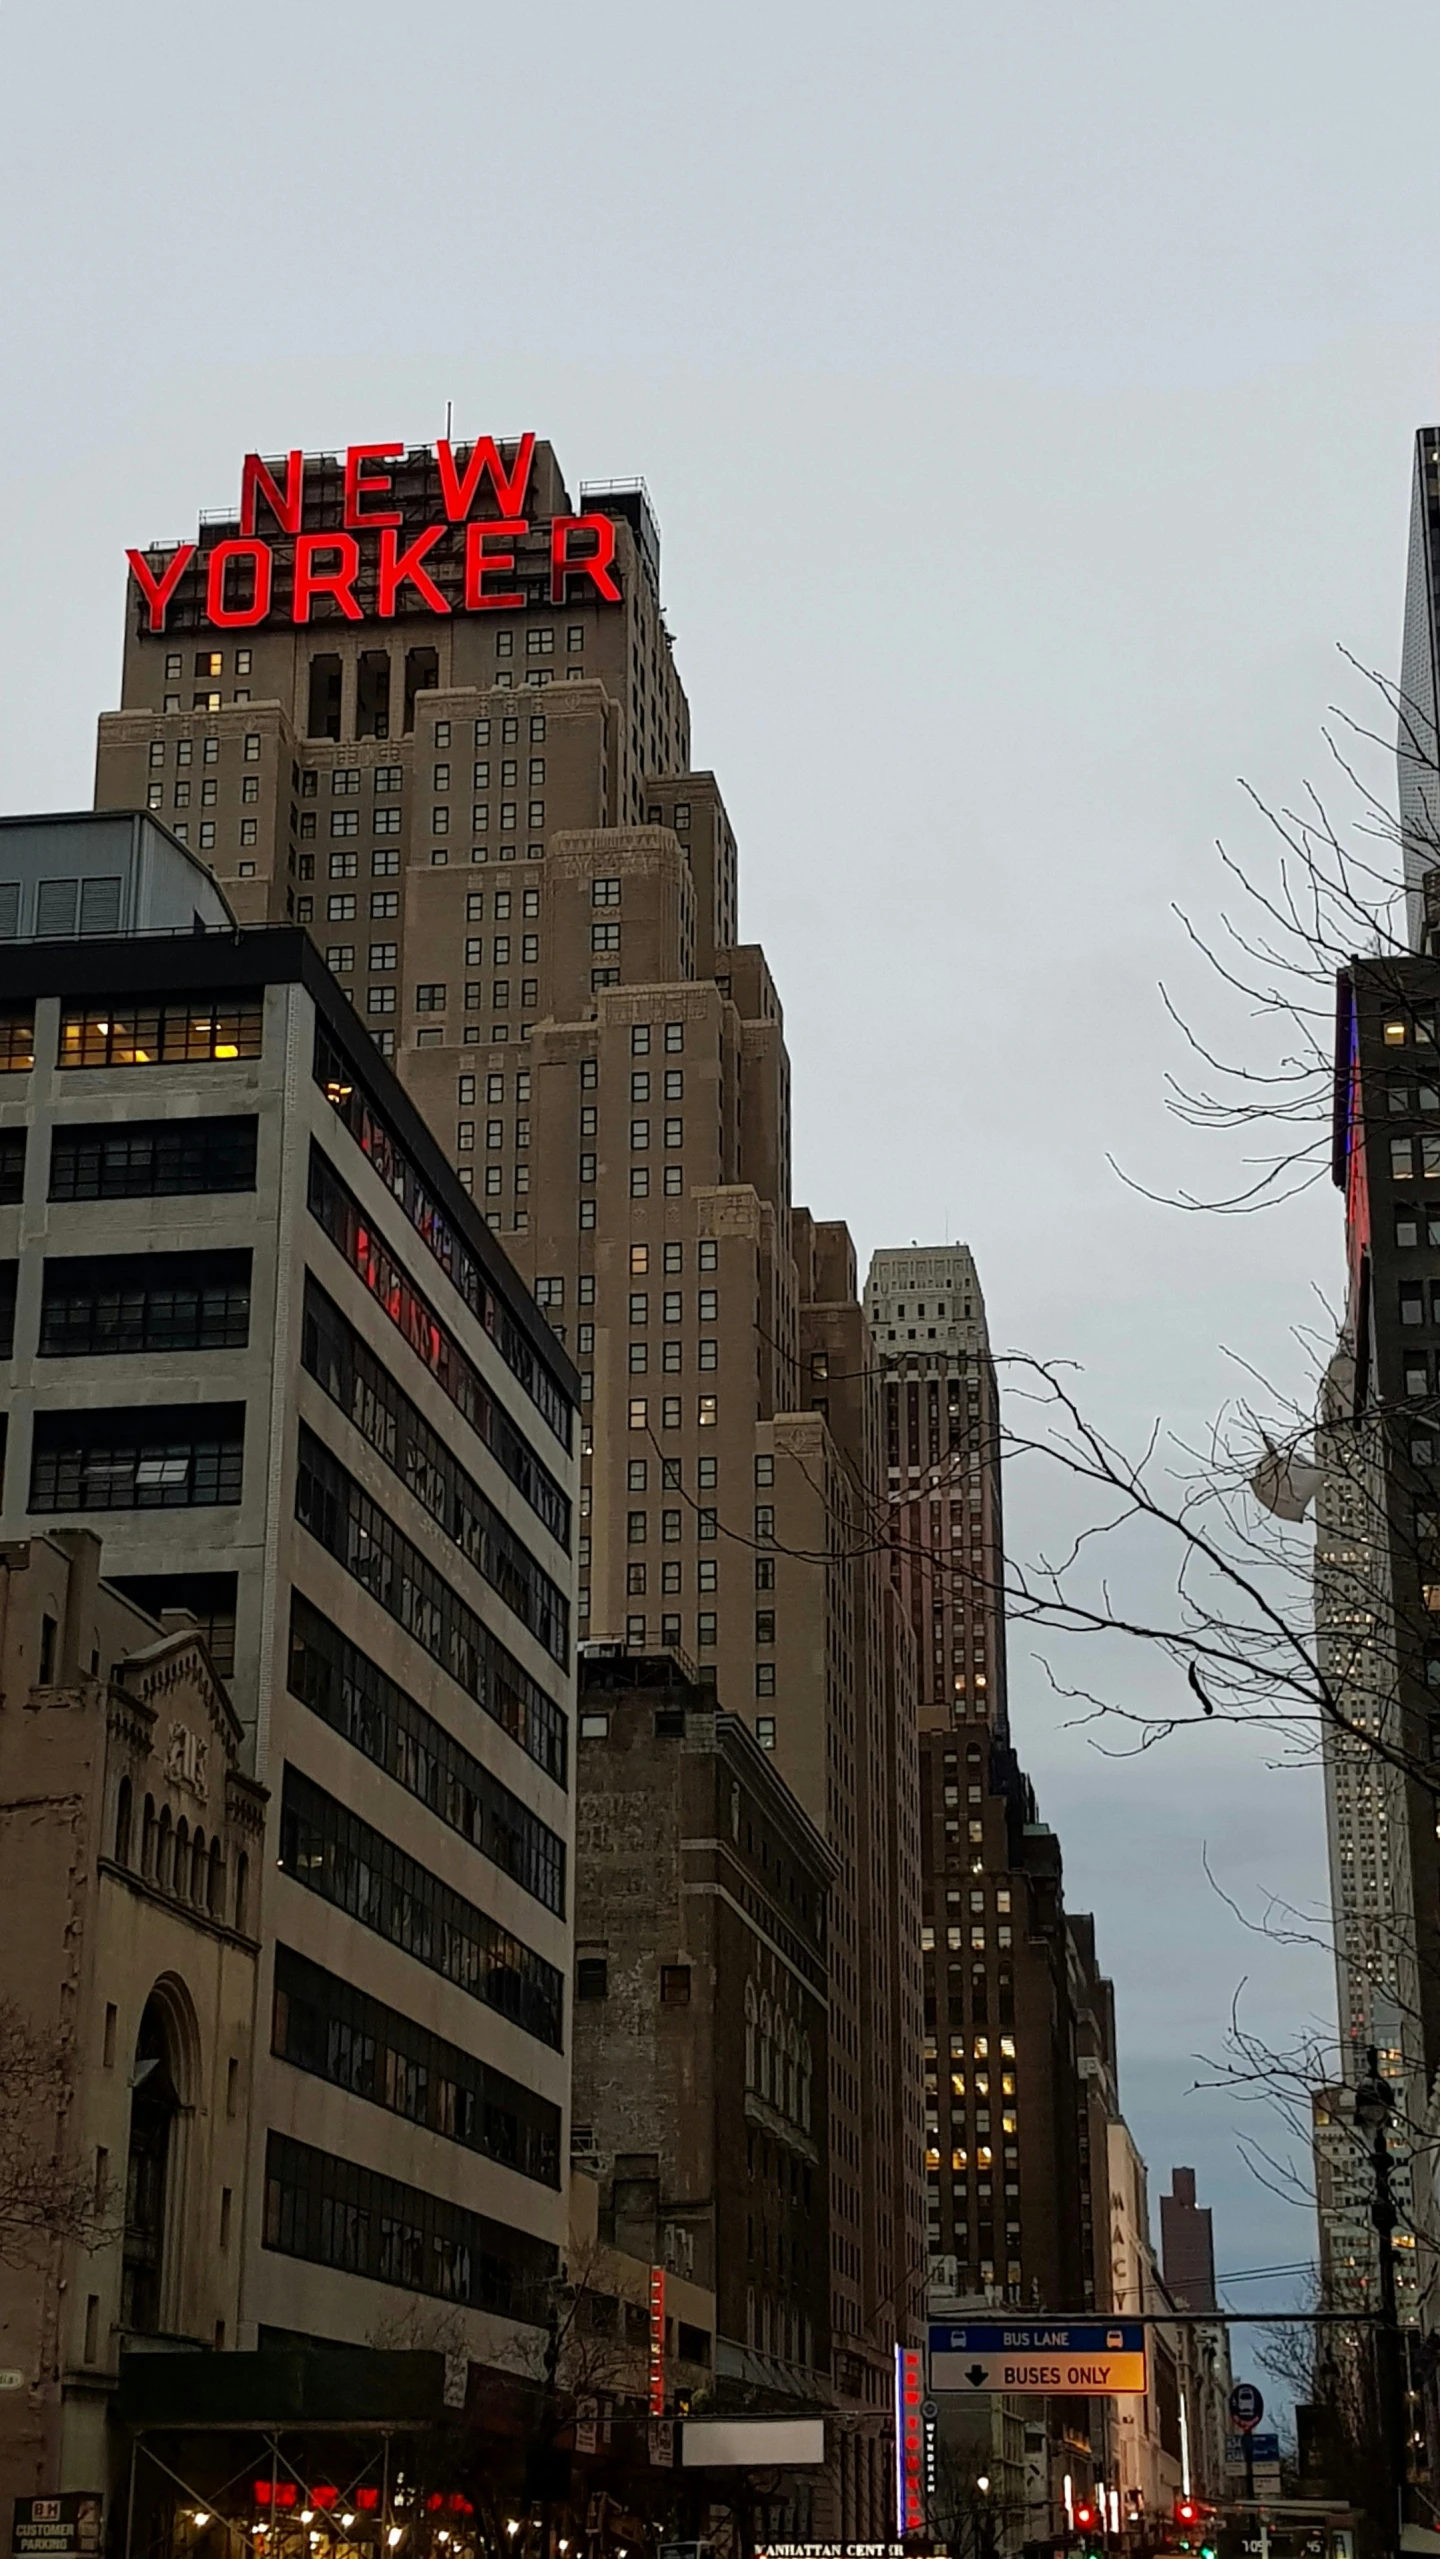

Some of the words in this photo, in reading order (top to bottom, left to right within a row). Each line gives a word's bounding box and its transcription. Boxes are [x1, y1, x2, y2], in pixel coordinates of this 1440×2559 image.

[240, 432, 536, 537] NEW
[124, 513, 622, 633] YORKER
[1003, 2332, 1030, 2346] BUS
[1034, 2332, 1070, 2346] LANE
[1004, 2367, 1061, 2384] BUSES
[1067, 2367, 1112, 2384] ONLY
[926, 2422, 935, 2493] WYNDHAM
[15, 2523, 75, 2537] CUSTOMER
[20, 2538, 68, 2551] PARKING
